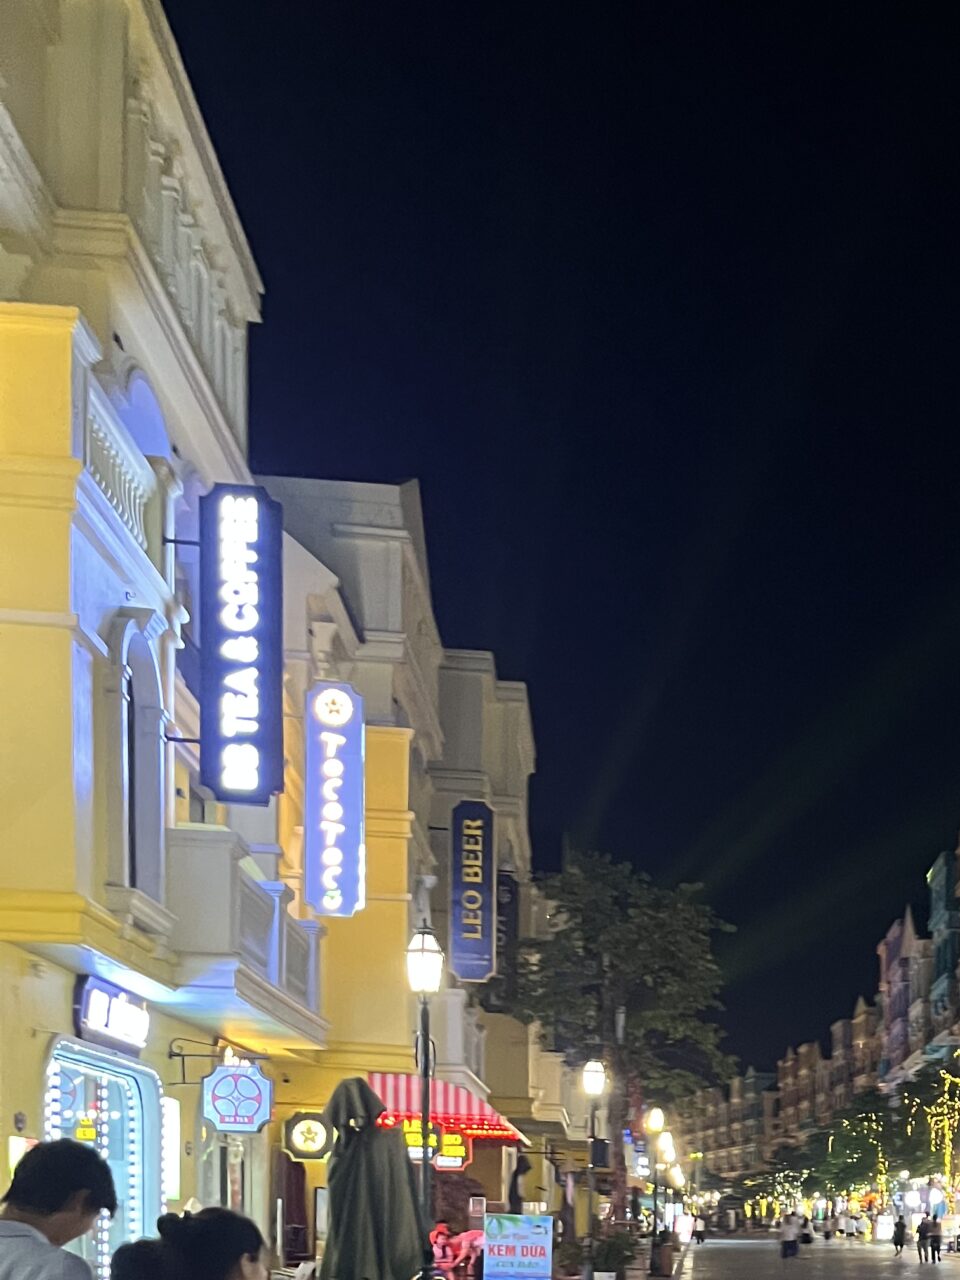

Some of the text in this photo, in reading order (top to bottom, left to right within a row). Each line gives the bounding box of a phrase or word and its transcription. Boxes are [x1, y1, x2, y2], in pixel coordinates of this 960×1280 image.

[220, 495, 259, 632] COFFEE
[222, 667, 259, 738] TEA
[461, 819, 484, 940] LEO BEER
[488, 1243, 516, 1257] KEM
